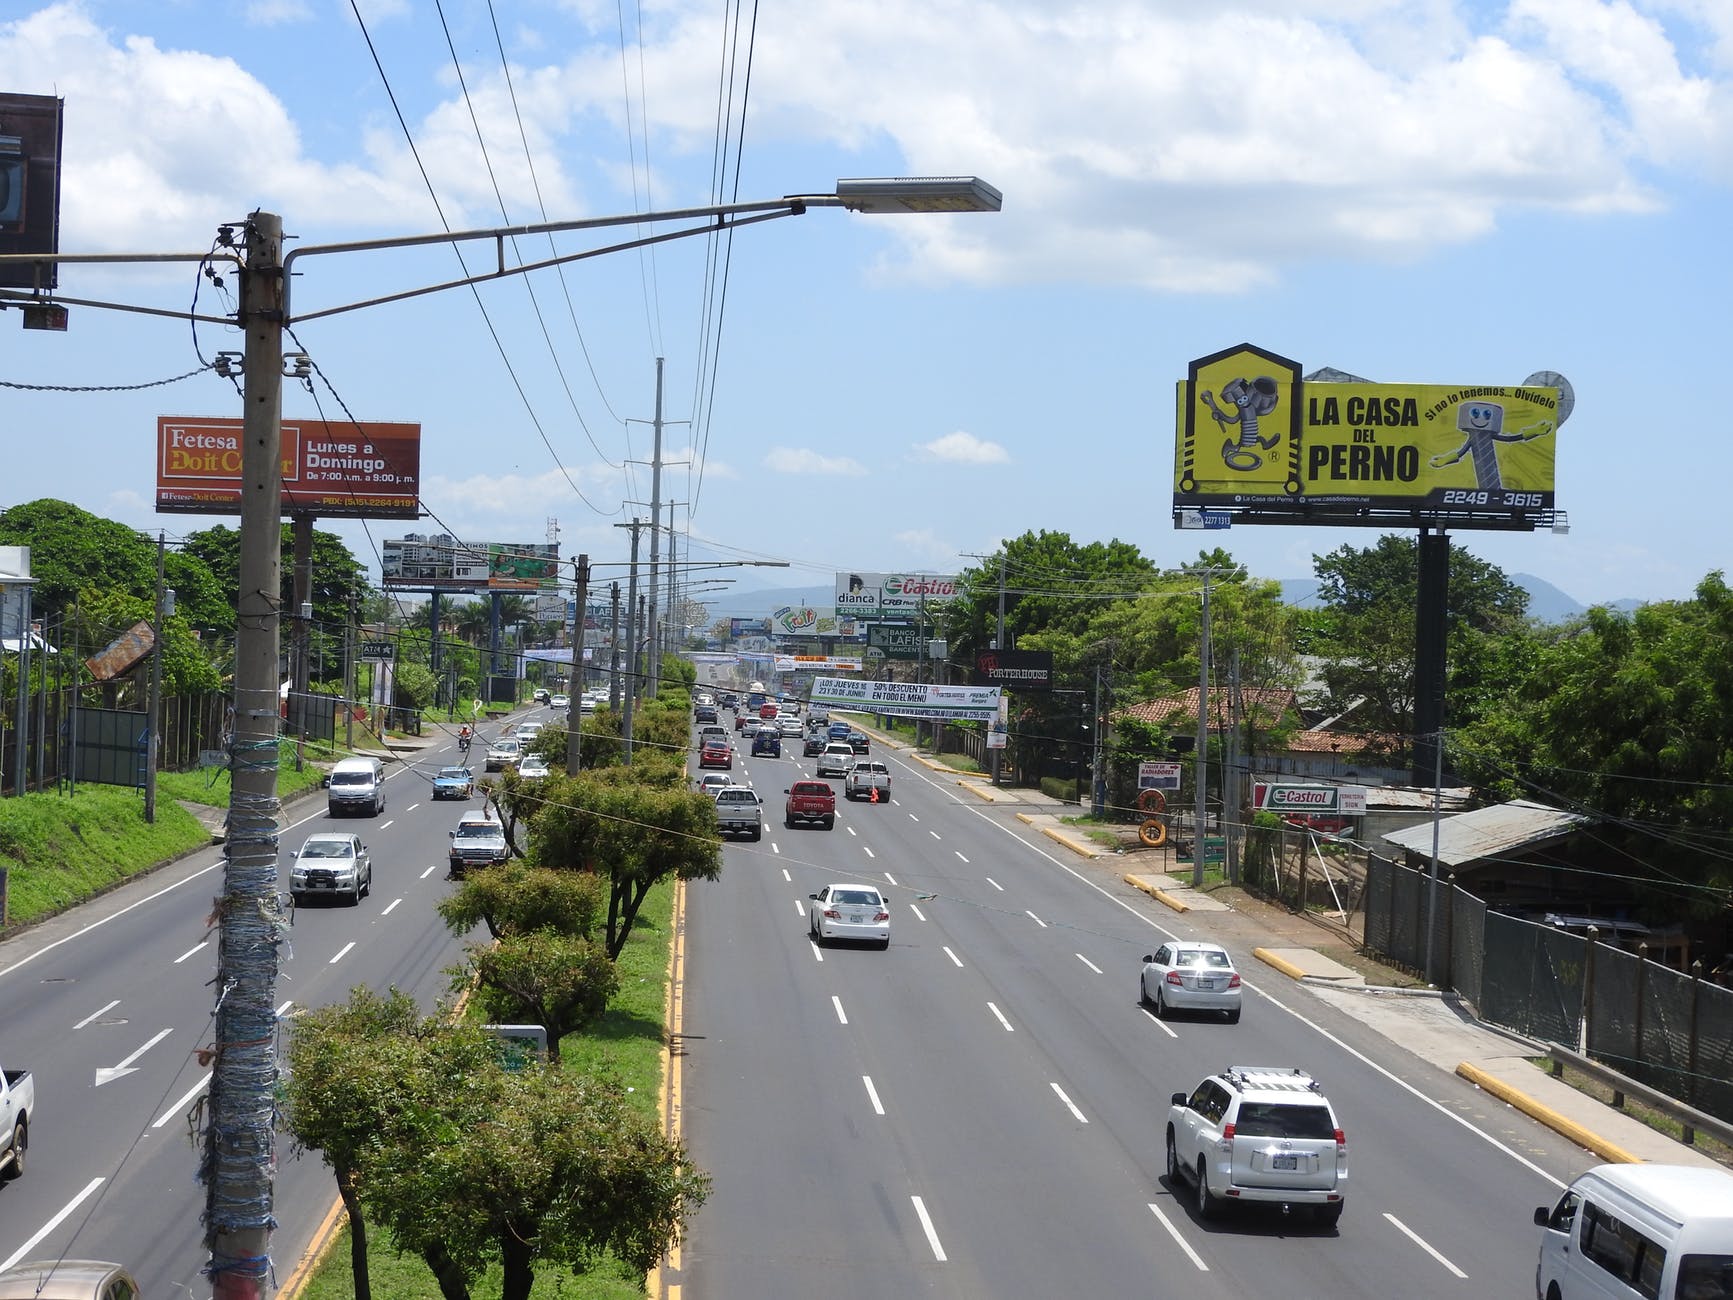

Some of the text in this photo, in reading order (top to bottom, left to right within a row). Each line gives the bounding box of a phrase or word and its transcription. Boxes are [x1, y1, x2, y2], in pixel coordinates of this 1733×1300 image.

[1309, 396, 1419, 427] LA CASA
[1436, 401, 1448, 415] no
[171, 429, 238, 449] Fetesa
[1353, 429, 1376, 443] DEL
[307, 441, 374, 454] Lunes a
[306, 454, 385, 473] Domingo
[1308, 445, 1419, 482] PERNO
[306, 472, 319, 480] De
[320, 472, 342, 480] 7:00
[1443, 491, 1489, 505] 2249
[1503, 493, 1543, 507] 3615
[838, 593, 874, 603] dianca
[833, 681, 860, 690] JUEVES
[873, 683, 887, 692] 50%
[888, 684, 928, 694] DESCUENTO
[872, 692, 882, 700] EN
[882, 692, 899, 701] TODO
[899, 693, 907, 702] EL
[1287, 790, 1327, 803] Castrol
